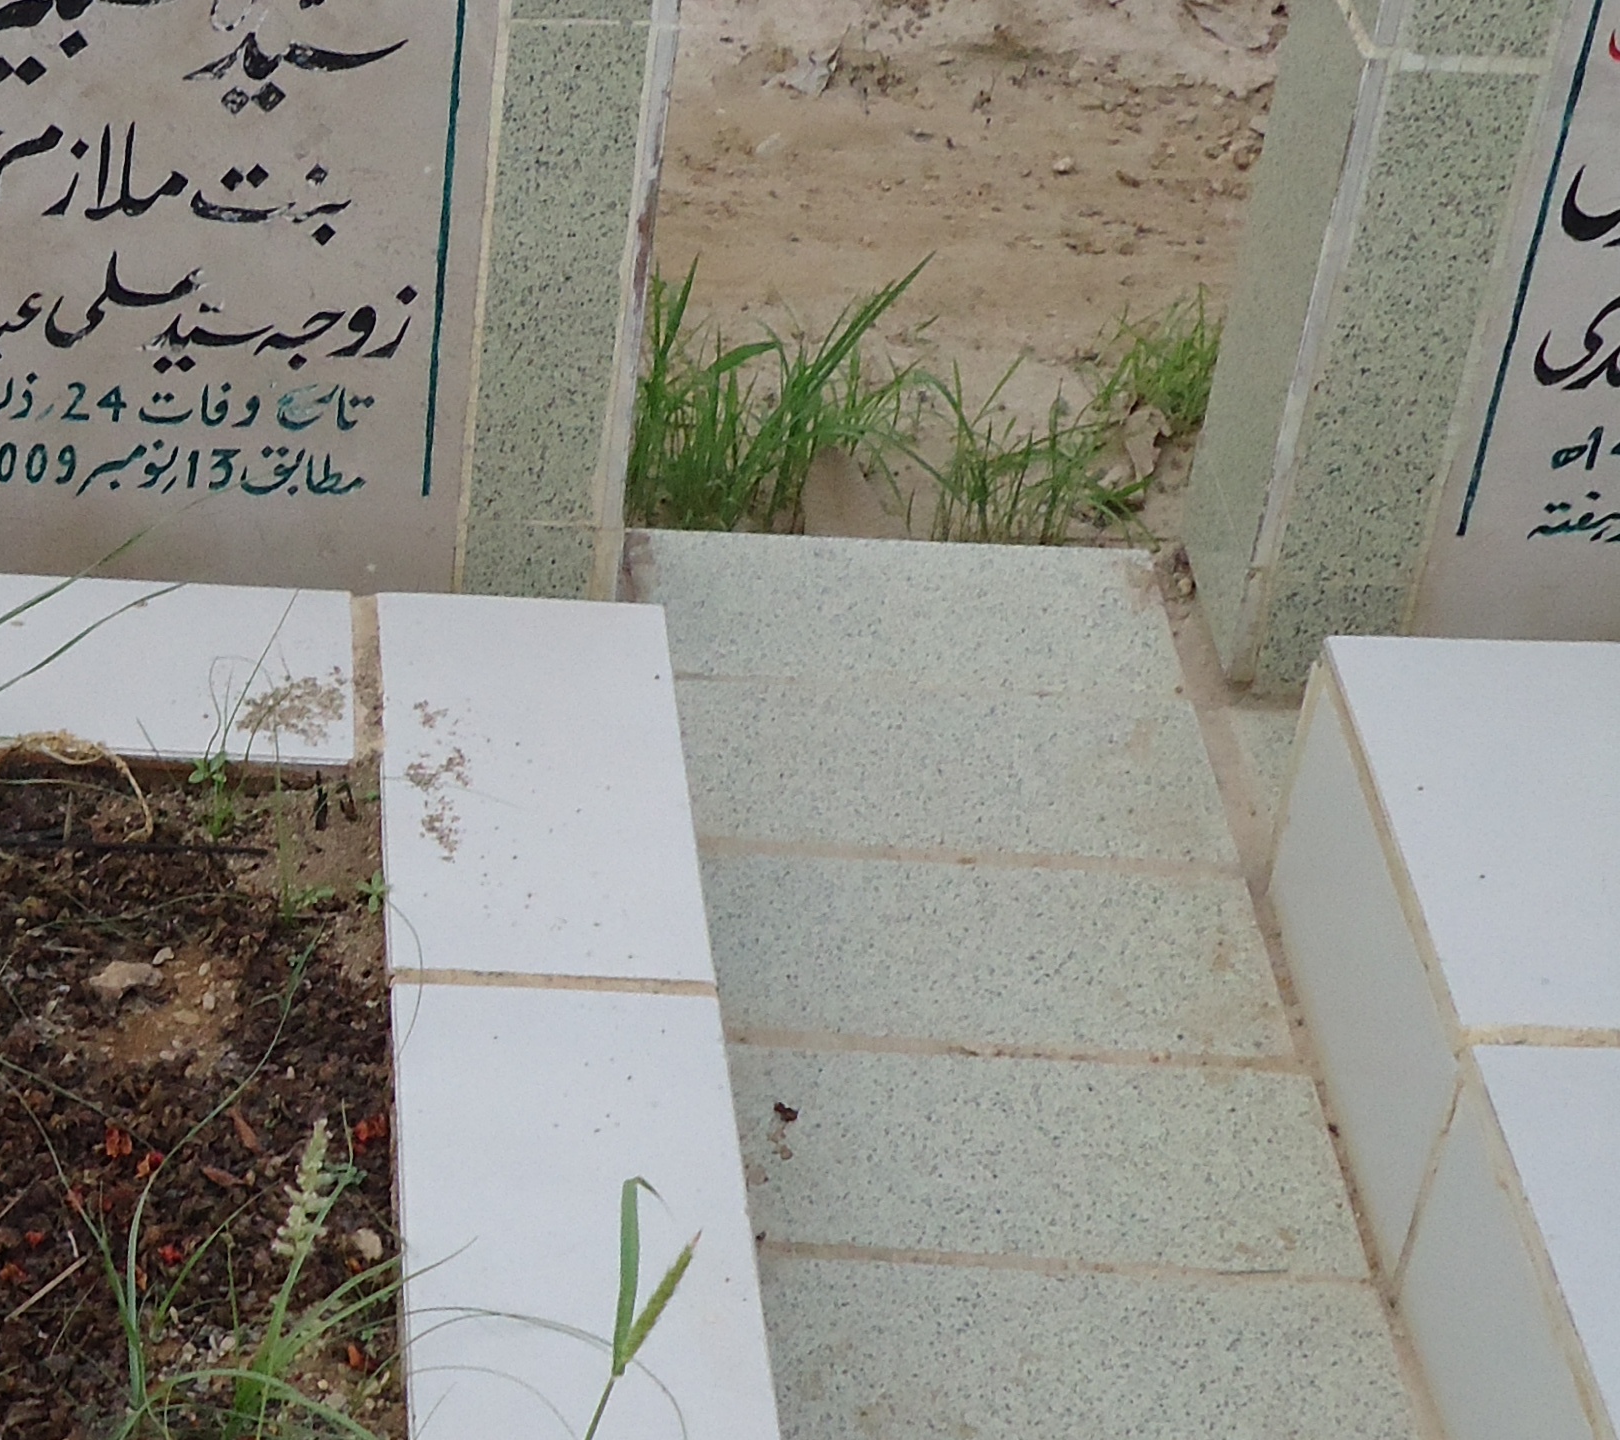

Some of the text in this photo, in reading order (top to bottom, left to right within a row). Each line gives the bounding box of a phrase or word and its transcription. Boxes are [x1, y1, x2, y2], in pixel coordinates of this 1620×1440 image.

[188, 163, 352, 245] بنت
[253, 283, 418, 371] زوجہ
[240, 445, 367, 496] مطابق
